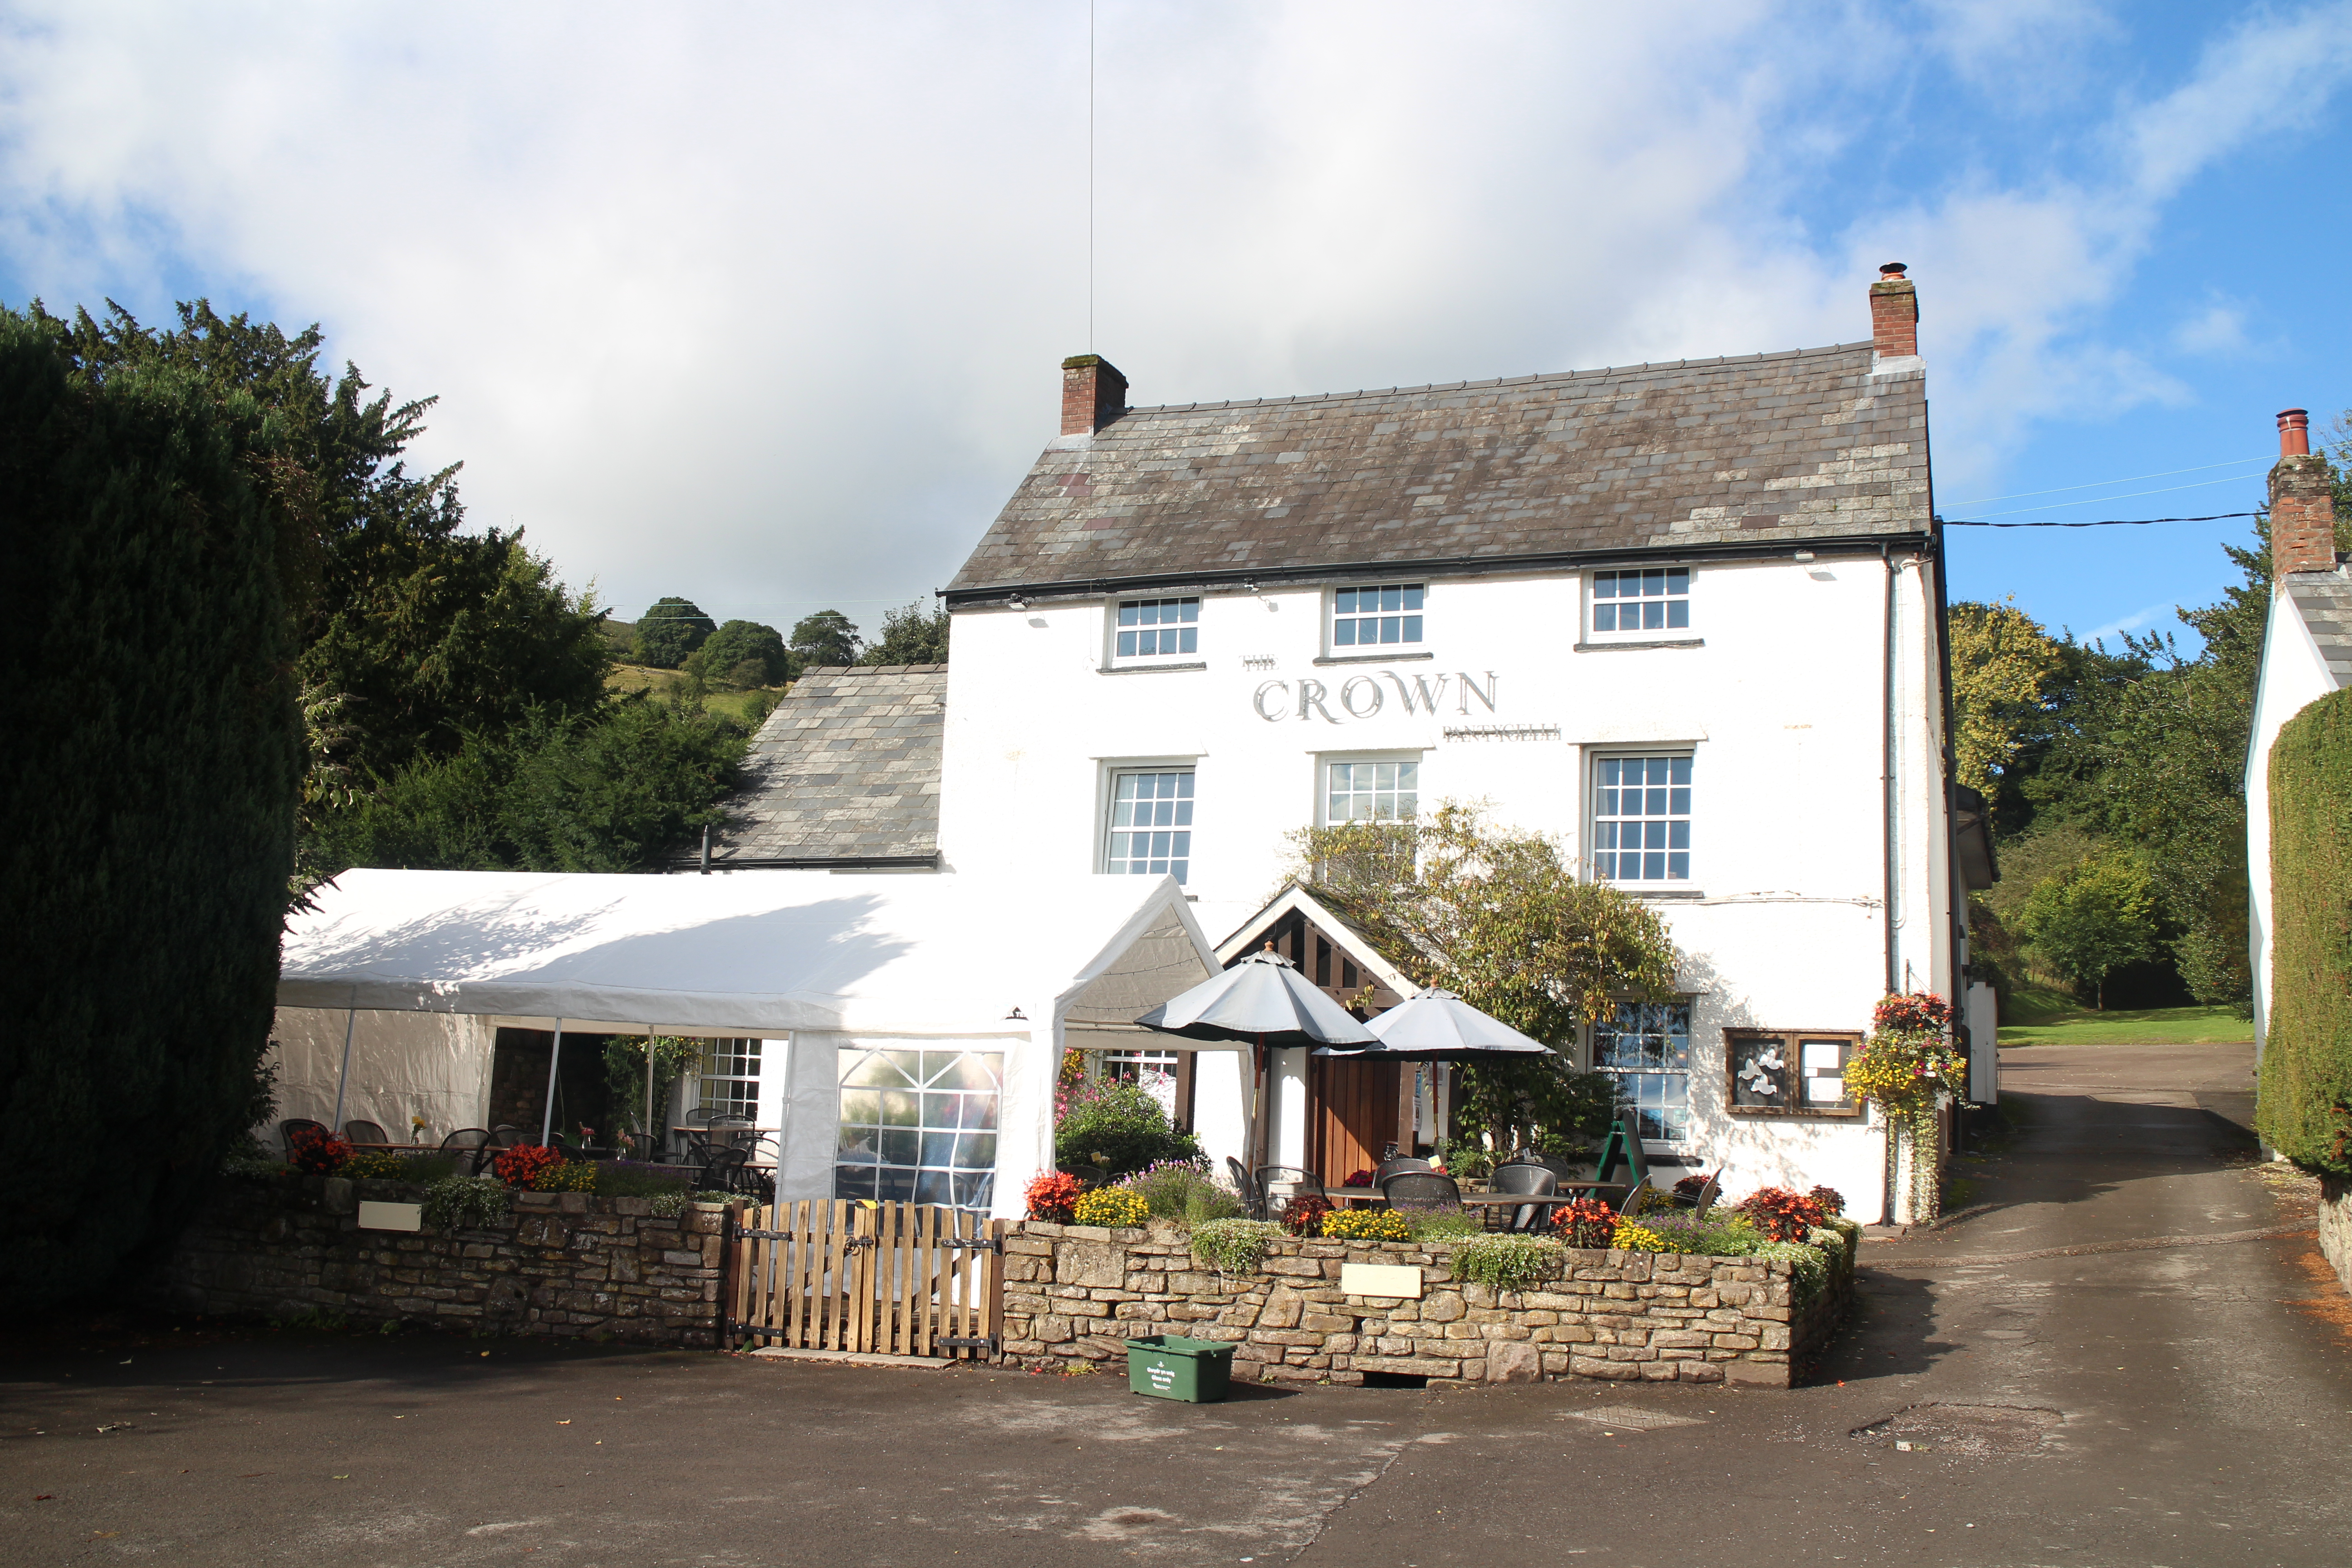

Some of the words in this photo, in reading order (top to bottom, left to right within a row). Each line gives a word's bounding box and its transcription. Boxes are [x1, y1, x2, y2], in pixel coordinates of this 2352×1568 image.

[1239, 654, 1276, 669] THE
[1253, 671, 1499, 724] CROWN
[1442, 723, 1559, 740] PANTYGELLI
